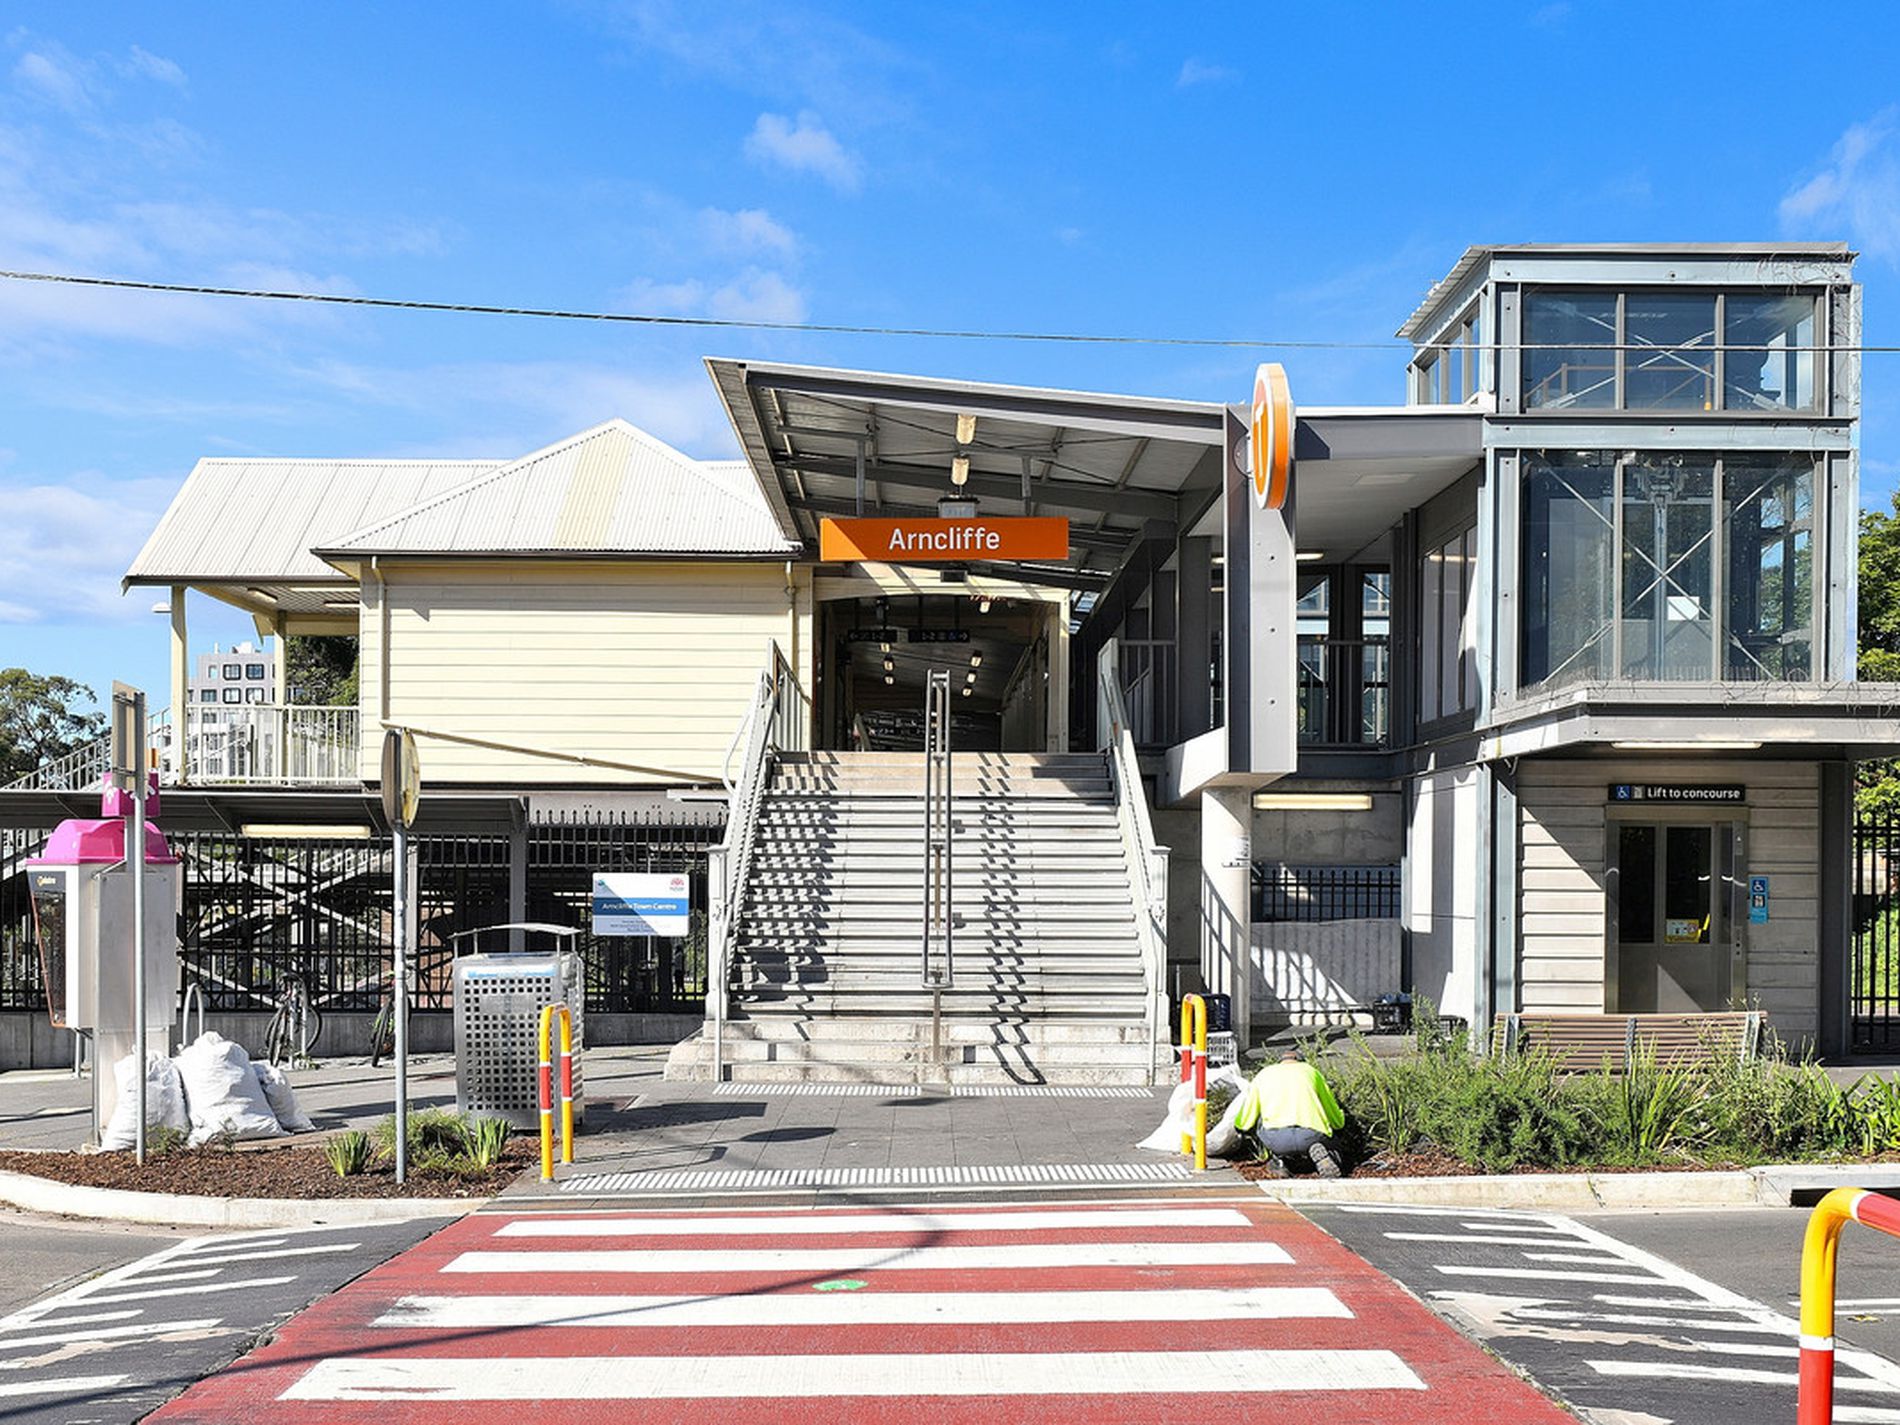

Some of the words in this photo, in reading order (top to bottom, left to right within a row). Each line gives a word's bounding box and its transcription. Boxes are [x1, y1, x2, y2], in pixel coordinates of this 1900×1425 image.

[889, 527, 1000, 550] Arncliffe
[1647, 787, 1667, 799] Lift
[1669, 788, 1681, 799] to
[1682, 789, 1741, 799] concourse
